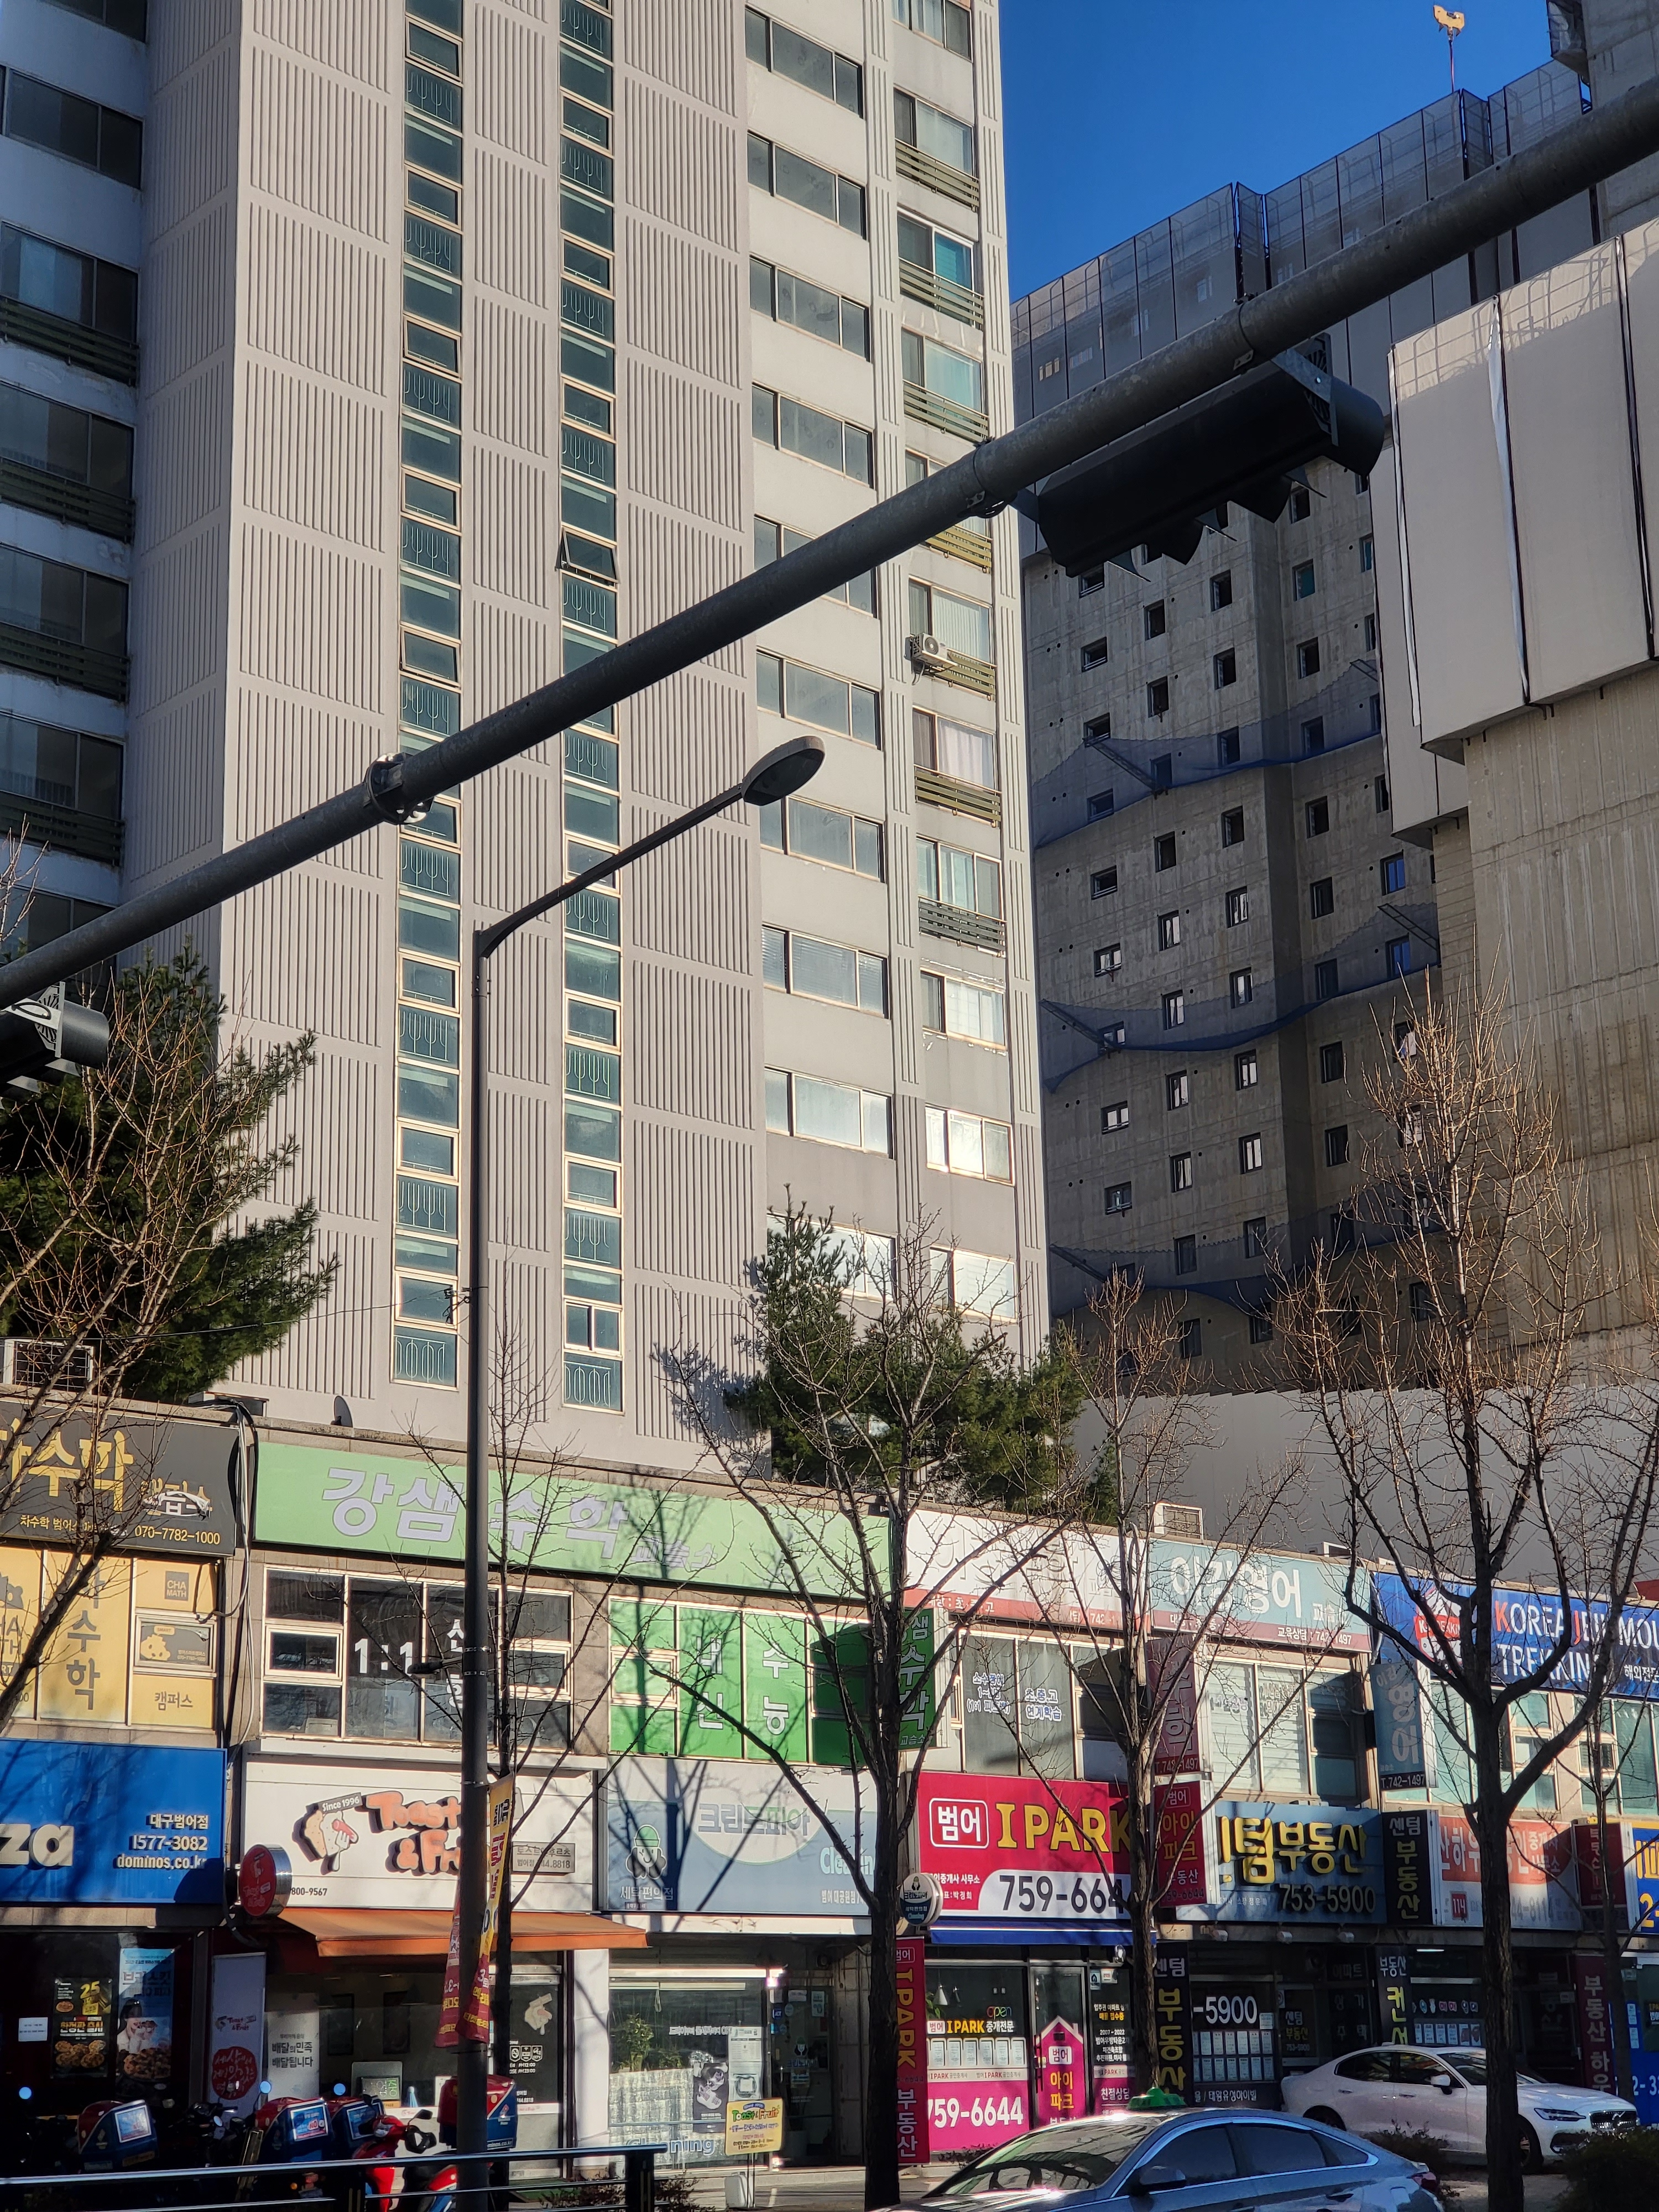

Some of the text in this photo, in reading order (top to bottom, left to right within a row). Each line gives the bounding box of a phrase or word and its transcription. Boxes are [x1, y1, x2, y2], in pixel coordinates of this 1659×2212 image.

[134, 1525, 221, 1546] 070-7782-1000
[167, 1579, 187, 1590] CHA
[166, 1589, 187, 1598] MATH
[1277, 1626, 1307, 1642] 교육상담
[762, 1639, 789, 1736] 수능
[154, 1691, 194, 1710] 캠퍼스
[1025, 1704, 1063, 1722] 연계학습
[1388, 1682, 1420, 1765] 영어
[1380, 1773, 1426, 1790] T.742-1497
[322, 1796, 360, 1812] Since 1996
[1168, 1789, 1187, 1806] 범어
[366, 1790, 462, 1830] Toast
[150, 1814, 209, 1830] 대구범어점
[698, 1802, 811, 1837] 크린토피아
[937, 1805, 981, 1843] 범어
[1389, 1815, 1421, 1837] 센텀
[132, 1835, 208, 1851] 1577-3082
[1278, 1821, 1371, 1875] 부동산
[517, 1859, 535, 1867] 범어점
[961, 1873, 980, 1885] 사무소
[1395, 1840, 1421, 1920] 부동산
[289, 1887, 328, 1896] 800-9567
[620, 1885, 674, 1901] 세탁편의점
[1279, 1882, 1376, 1914] 753-5900
[1379, 1955, 1407, 1978] 부동산
[987, 2006, 1012, 2020] open
[1584, 1975, 1606, 2043] 부동산
[929, 2022, 943, 2032] 범어
[985, 2020, 1015, 2033] 중개전문
[1285, 2011, 1304, 2026] 센텀
[1286, 2027, 1309, 2042] 부동산
[272, 2042, 313, 2054] 배달의민족
[1052, 2048, 1069, 2063] 범어
[272, 2056, 314, 2069] 배달됩니다
[1050, 2070, 1074, 2090] 아이
[1050, 2091, 1075, 2112] 파크
[732, 2109, 755, 2122] Toast
[758, 2106, 780, 2120] Fruit
[896, 2088, 918, 2158] 부동산
